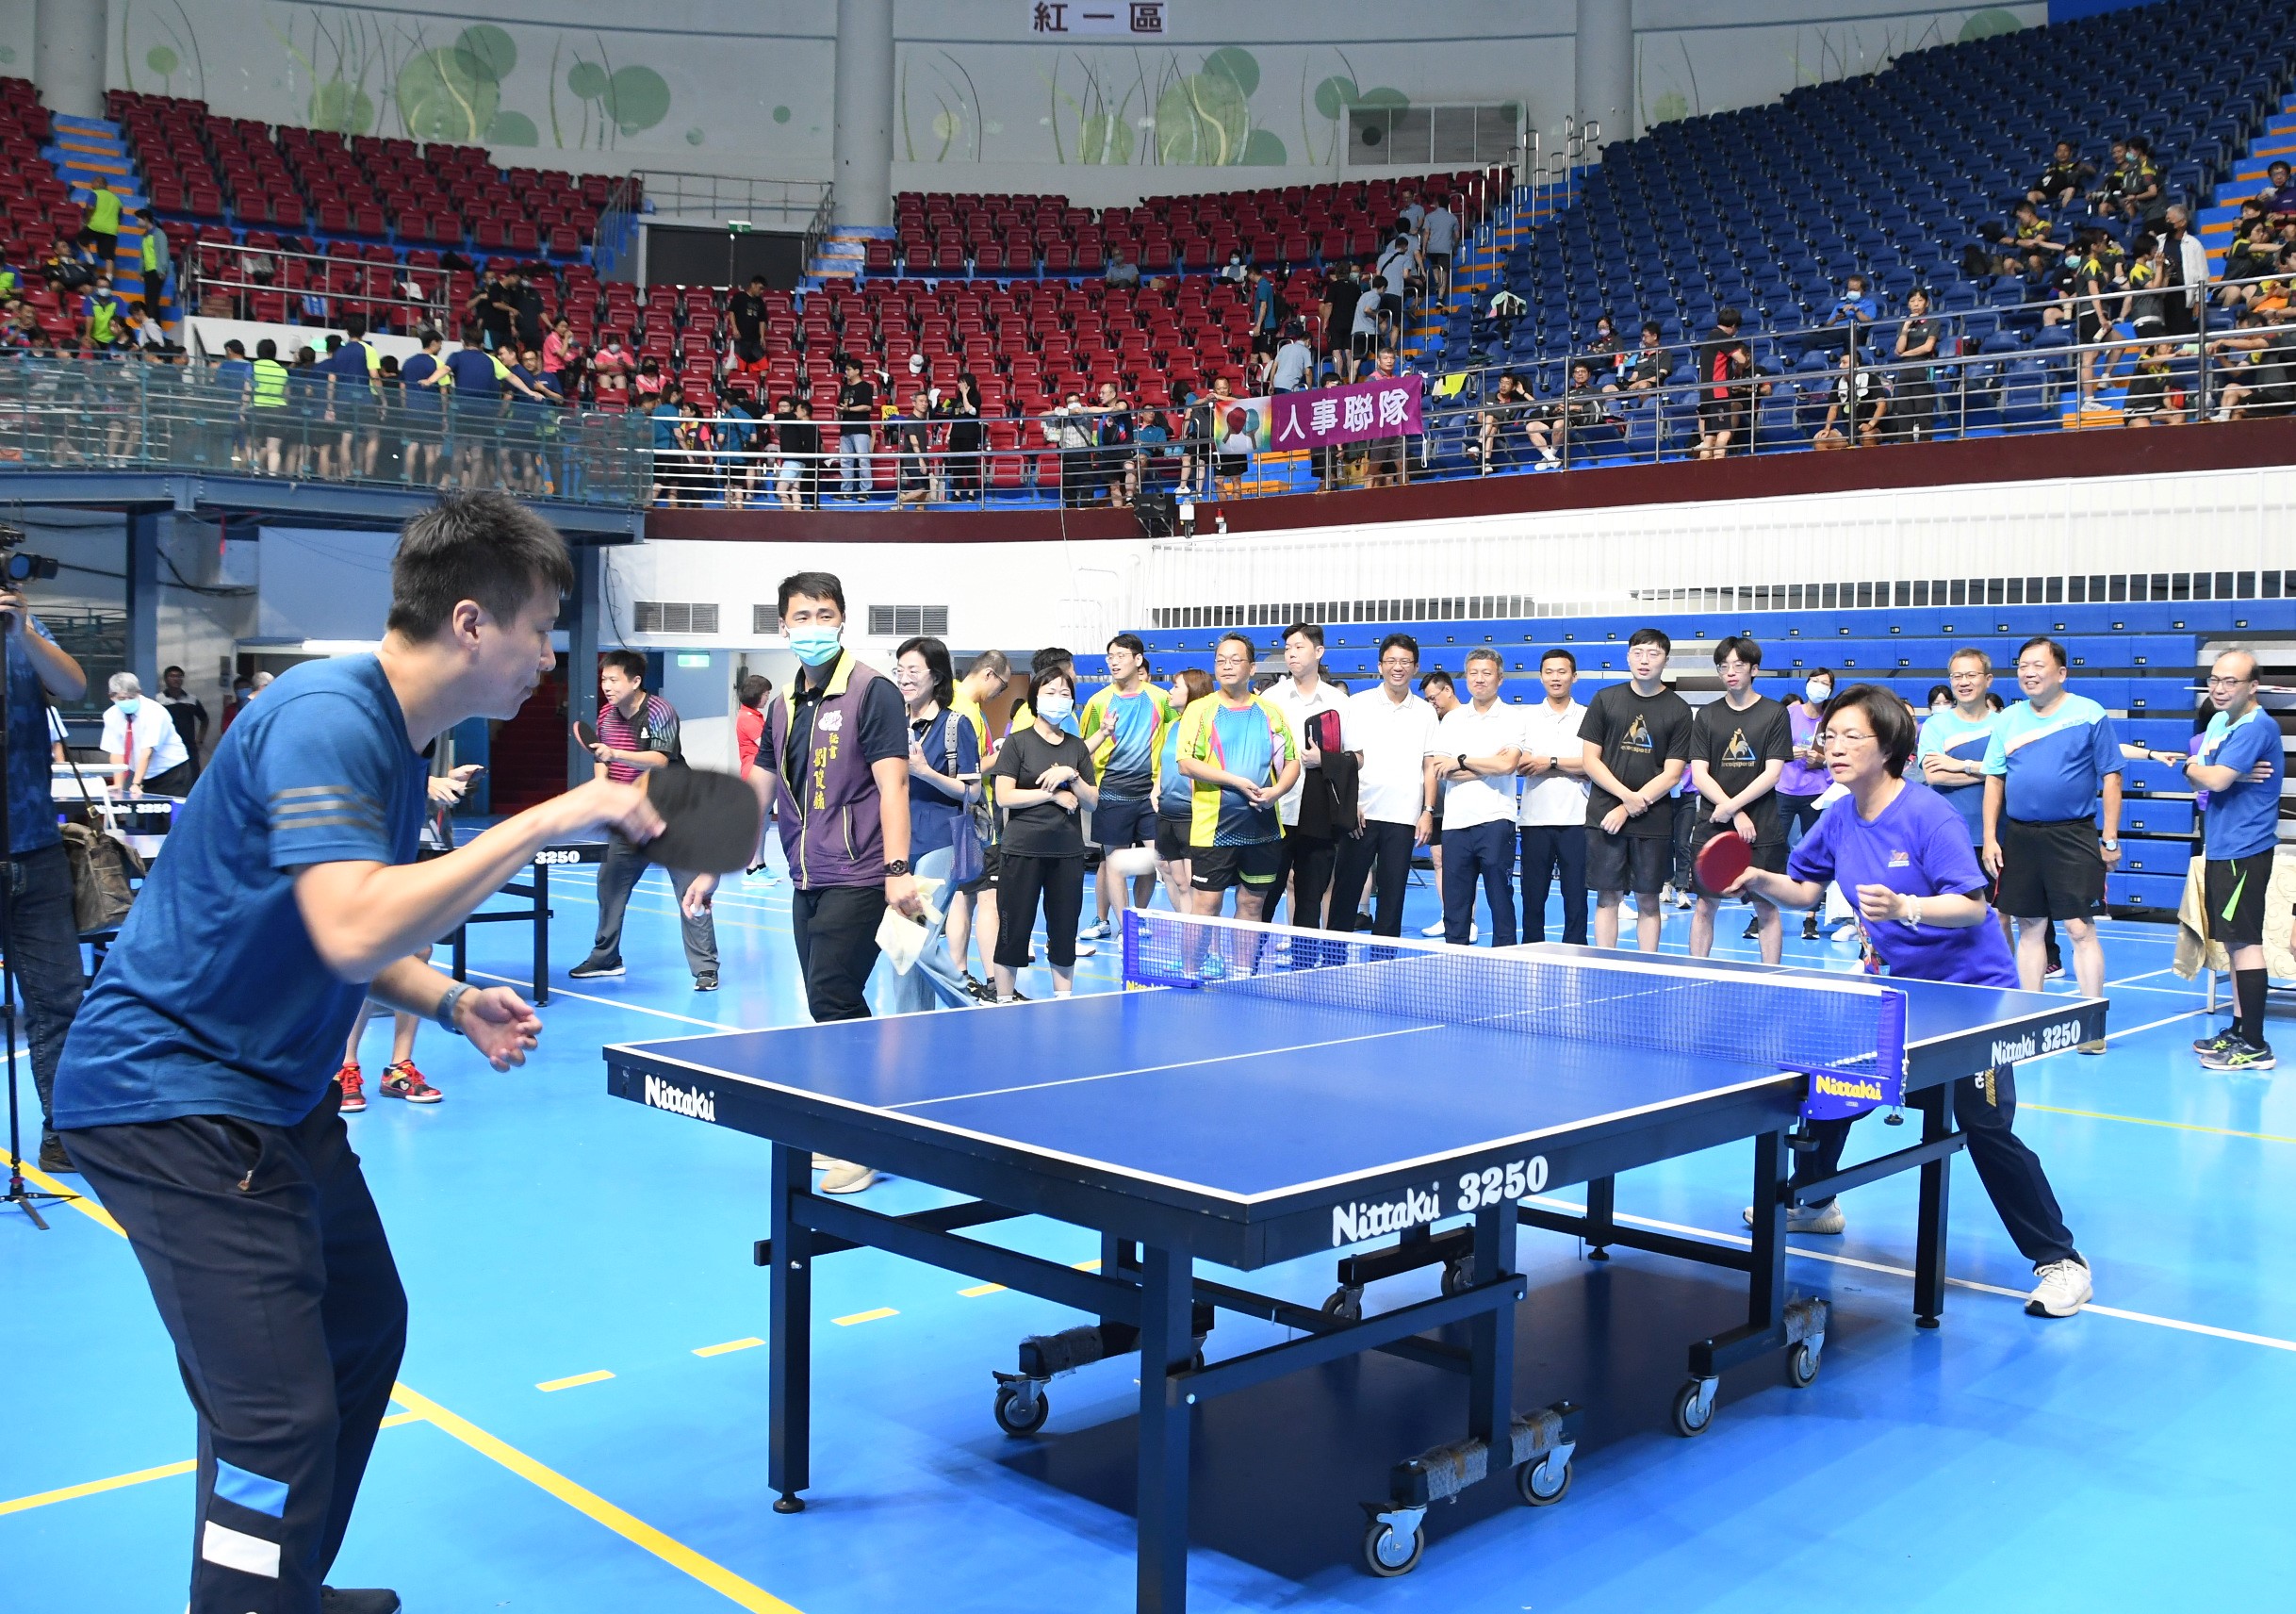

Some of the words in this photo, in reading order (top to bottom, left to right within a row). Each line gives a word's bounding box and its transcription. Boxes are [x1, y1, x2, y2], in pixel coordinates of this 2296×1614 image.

[1033, 1, 1164, 33] 紅一區
[1278, 387, 1411, 443] 人事聯隊
[136, 803, 172, 814] 3250
[534, 850, 581, 865] 3250
[1991, 1031, 2036, 1068] Nittaku
[2042, 1019, 2081, 1052] 3250
[645, 1074, 716, 1123] Nittaku
[1815, 1075, 1883, 1101] Nittaku
[1332, 1180, 1441, 1246] Nittaku
[1457, 1155, 1549, 1212] 3250
